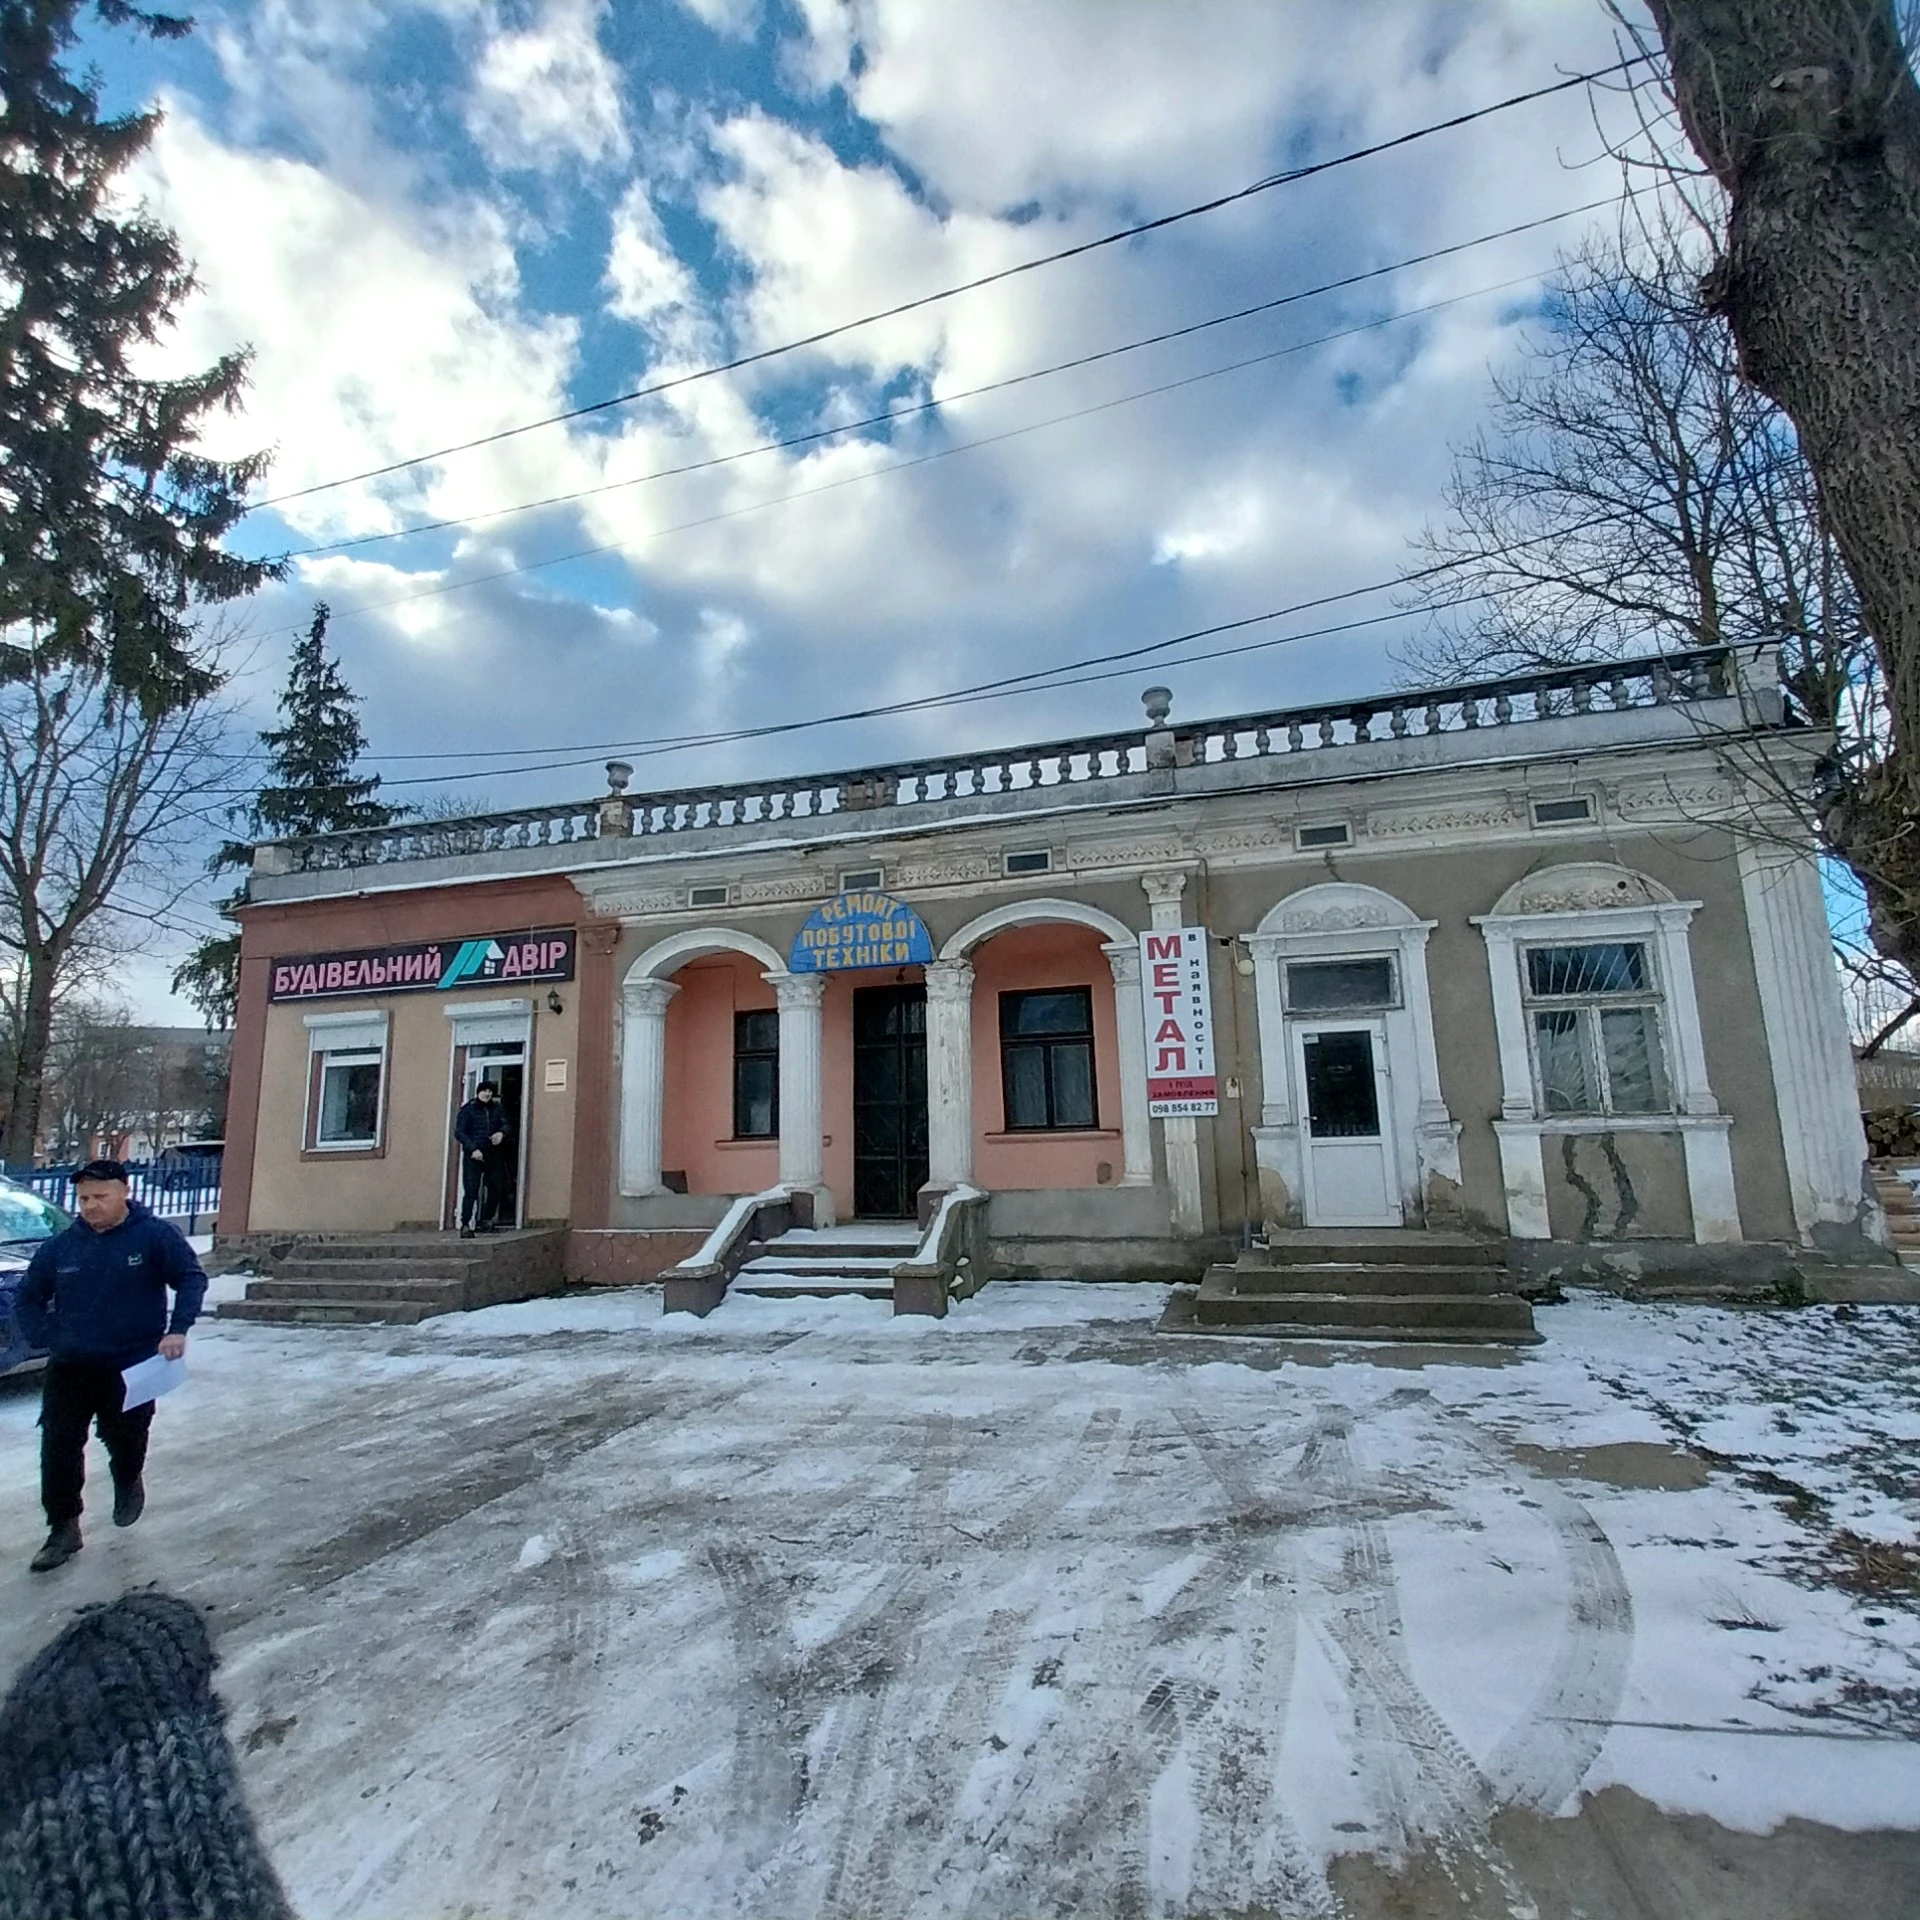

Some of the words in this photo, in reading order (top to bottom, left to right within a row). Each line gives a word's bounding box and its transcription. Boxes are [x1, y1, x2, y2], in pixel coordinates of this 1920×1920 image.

[822, 894, 898, 922] РЕМОНТ
[274, 946, 442, 994] БУДІВЕЛЬНИЙ
[501, 941, 567, 976] ДВІР
[813, 942, 909, 968] ТЕХНІКИ
[1147, 935, 1186, 1071] МЕТАЛ
[1190, 959, 1205, 1070] наявності
[1152, 1104, 1169, 1113] 098
[1171, 1103, 1188, 1112] 854
[1190, 1102, 1202, 1111] 82
[1204, 1102, 1215, 1111] 77
